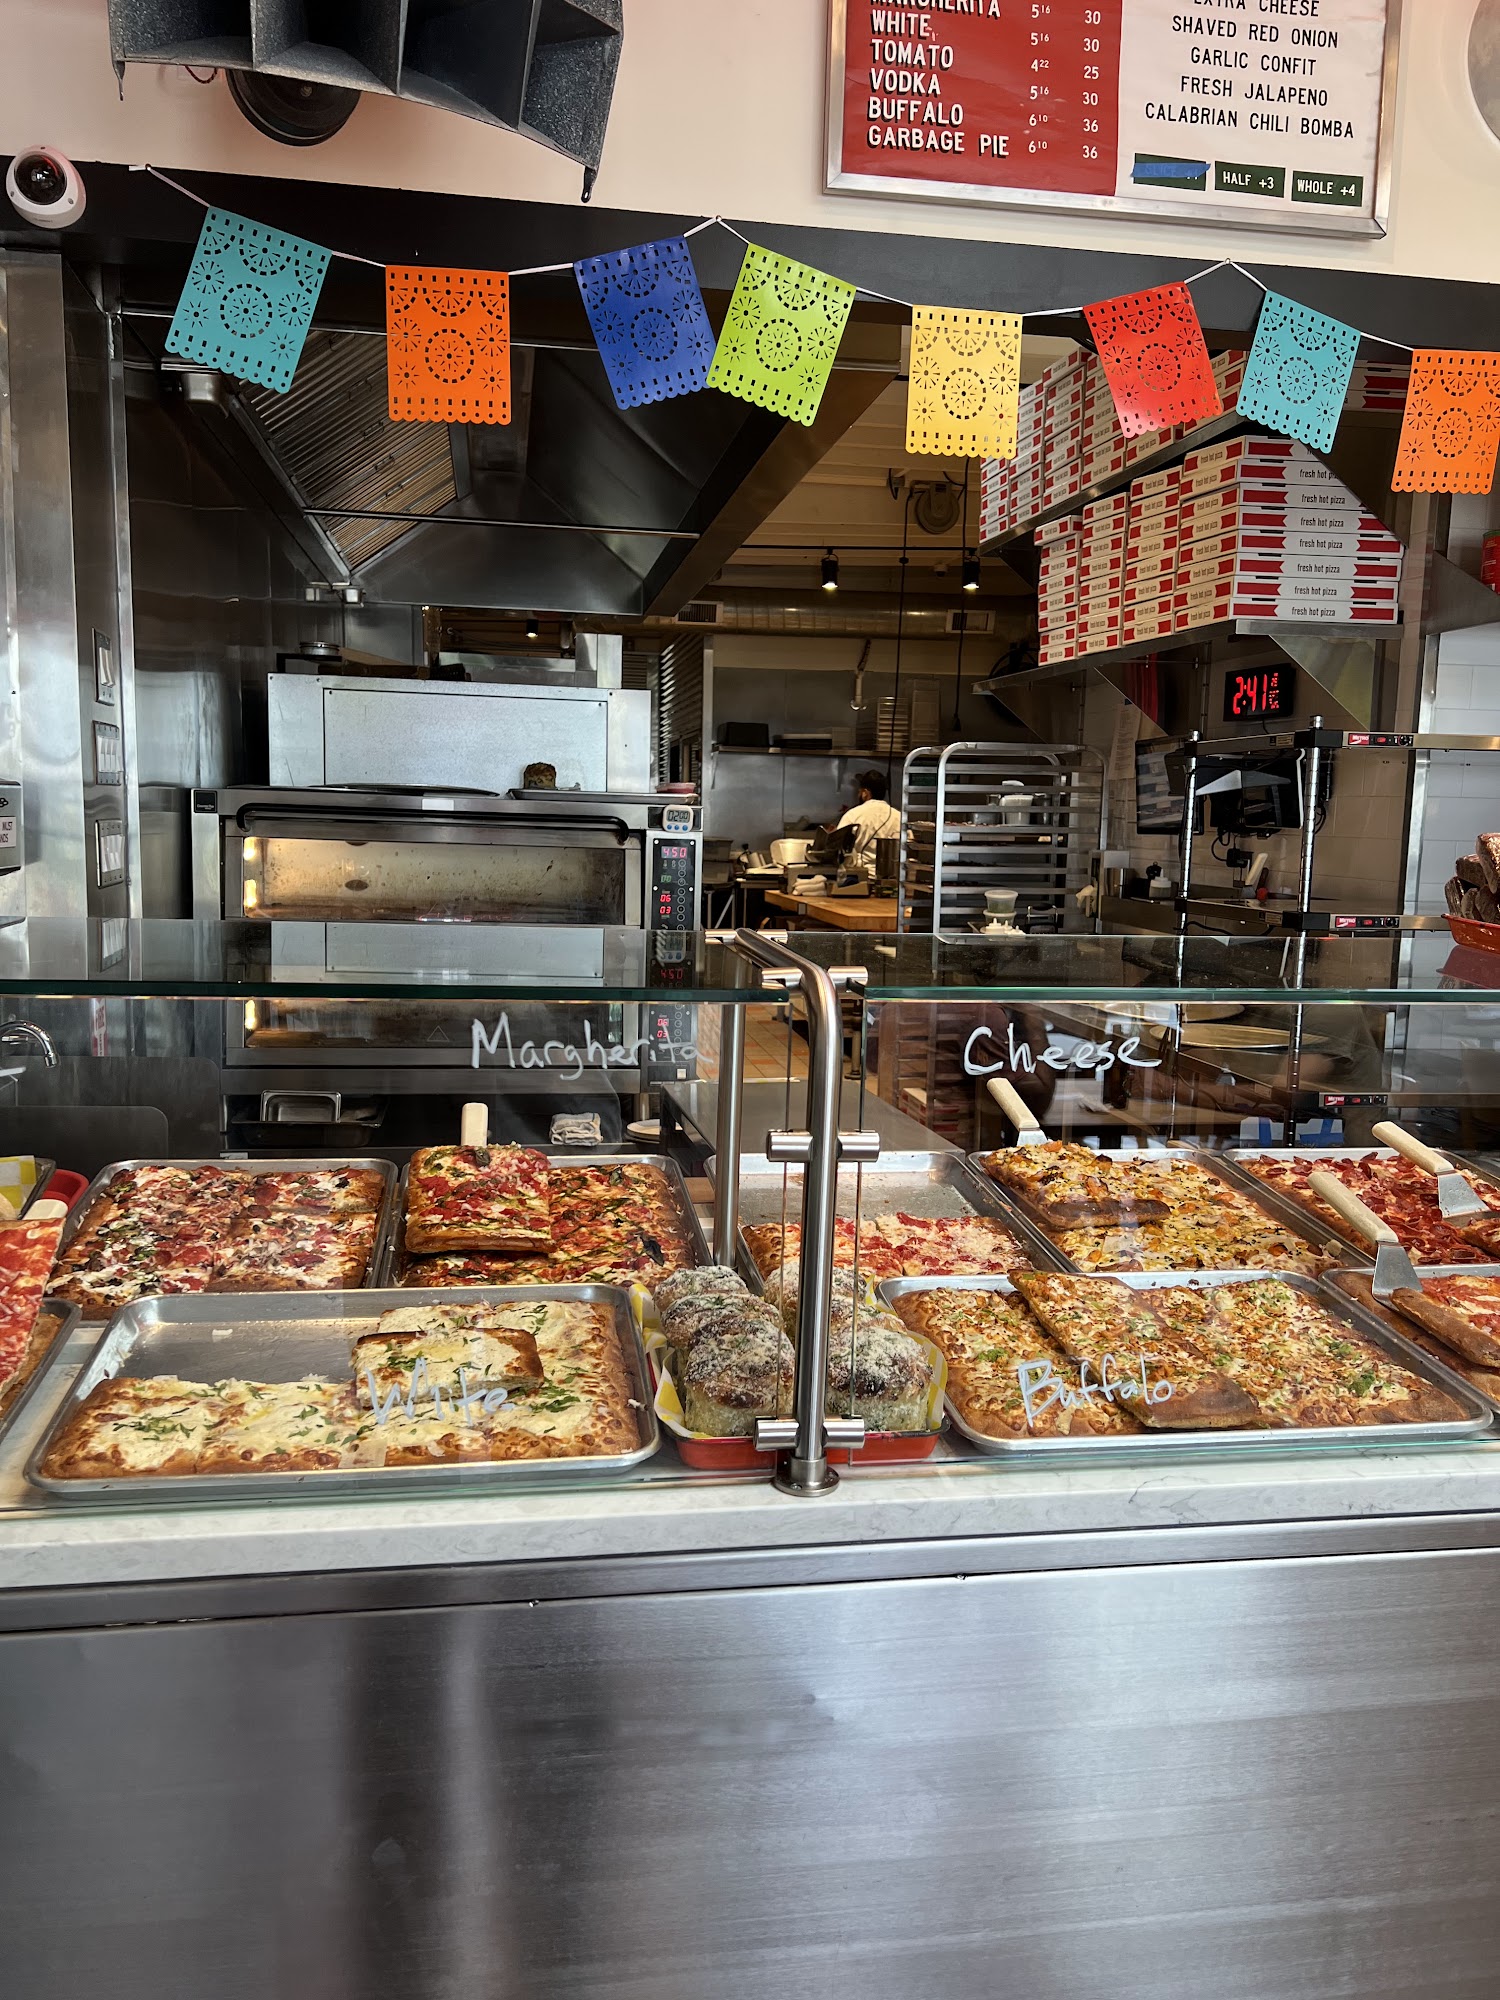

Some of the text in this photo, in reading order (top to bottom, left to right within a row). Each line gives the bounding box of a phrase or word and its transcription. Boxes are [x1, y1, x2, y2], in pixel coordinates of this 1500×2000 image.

[1084, 10, 1101, 25] 30
[1259, 0, 1319, 17] CHEESE
[872, 9, 931, 37] WHITE
[1083, 38, 1100, 53] 30
[1172, 15, 1338, 49] SHAVED RED ONION
[871, 38, 954, 69] TOMATO
[1083, 65, 1099, 80] 25
[1191, 46, 1317, 76] GARLIC CONFIT
[870, 68, 941, 95] VODKA
[1082, 91, 1098, 106] 30
[1181, 75, 1328, 107] FRESH JALAPENO
[868, 96, 964, 126] BUFFALO
[1082, 118, 1099, 133] 36
[1145, 102, 1354, 139] CALABRIAN CHILI BOMBA
[868, 125, 965, 153] GARBAGE
[980, 133, 1010, 156] PIE
[1082, 145, 1098, 159] 36
[1222, 171, 1275, 190] HALF +3
[1297, 179, 1356, 197] WHOLE +4
[1300, 469, 1315, 478] fresh
[1317, 470, 1326, 479] hot
[1302, 494, 1345, 505] fresh hot pizza
[1300, 517, 1344, 528] fresh hot pizza
[1300, 539, 1342, 550] fresh hot pizza
[1298, 564, 1340, 574] fresh hot pizza
[1295, 586, 1337, 596] fresh hot pizza
[1292, 607, 1335, 617] fresh hot pizza
[1233, 674, 1268, 714] 2:41
[663, 847, 687, 858] 450
[660, 894, 671, 903] 06
[660, 906, 671, 914] 03
[471, 1011, 714, 1080] Margherita
[963, 1022, 1163, 1076] Cheese
[1018, 1352, 1174, 1428] Buffalo
